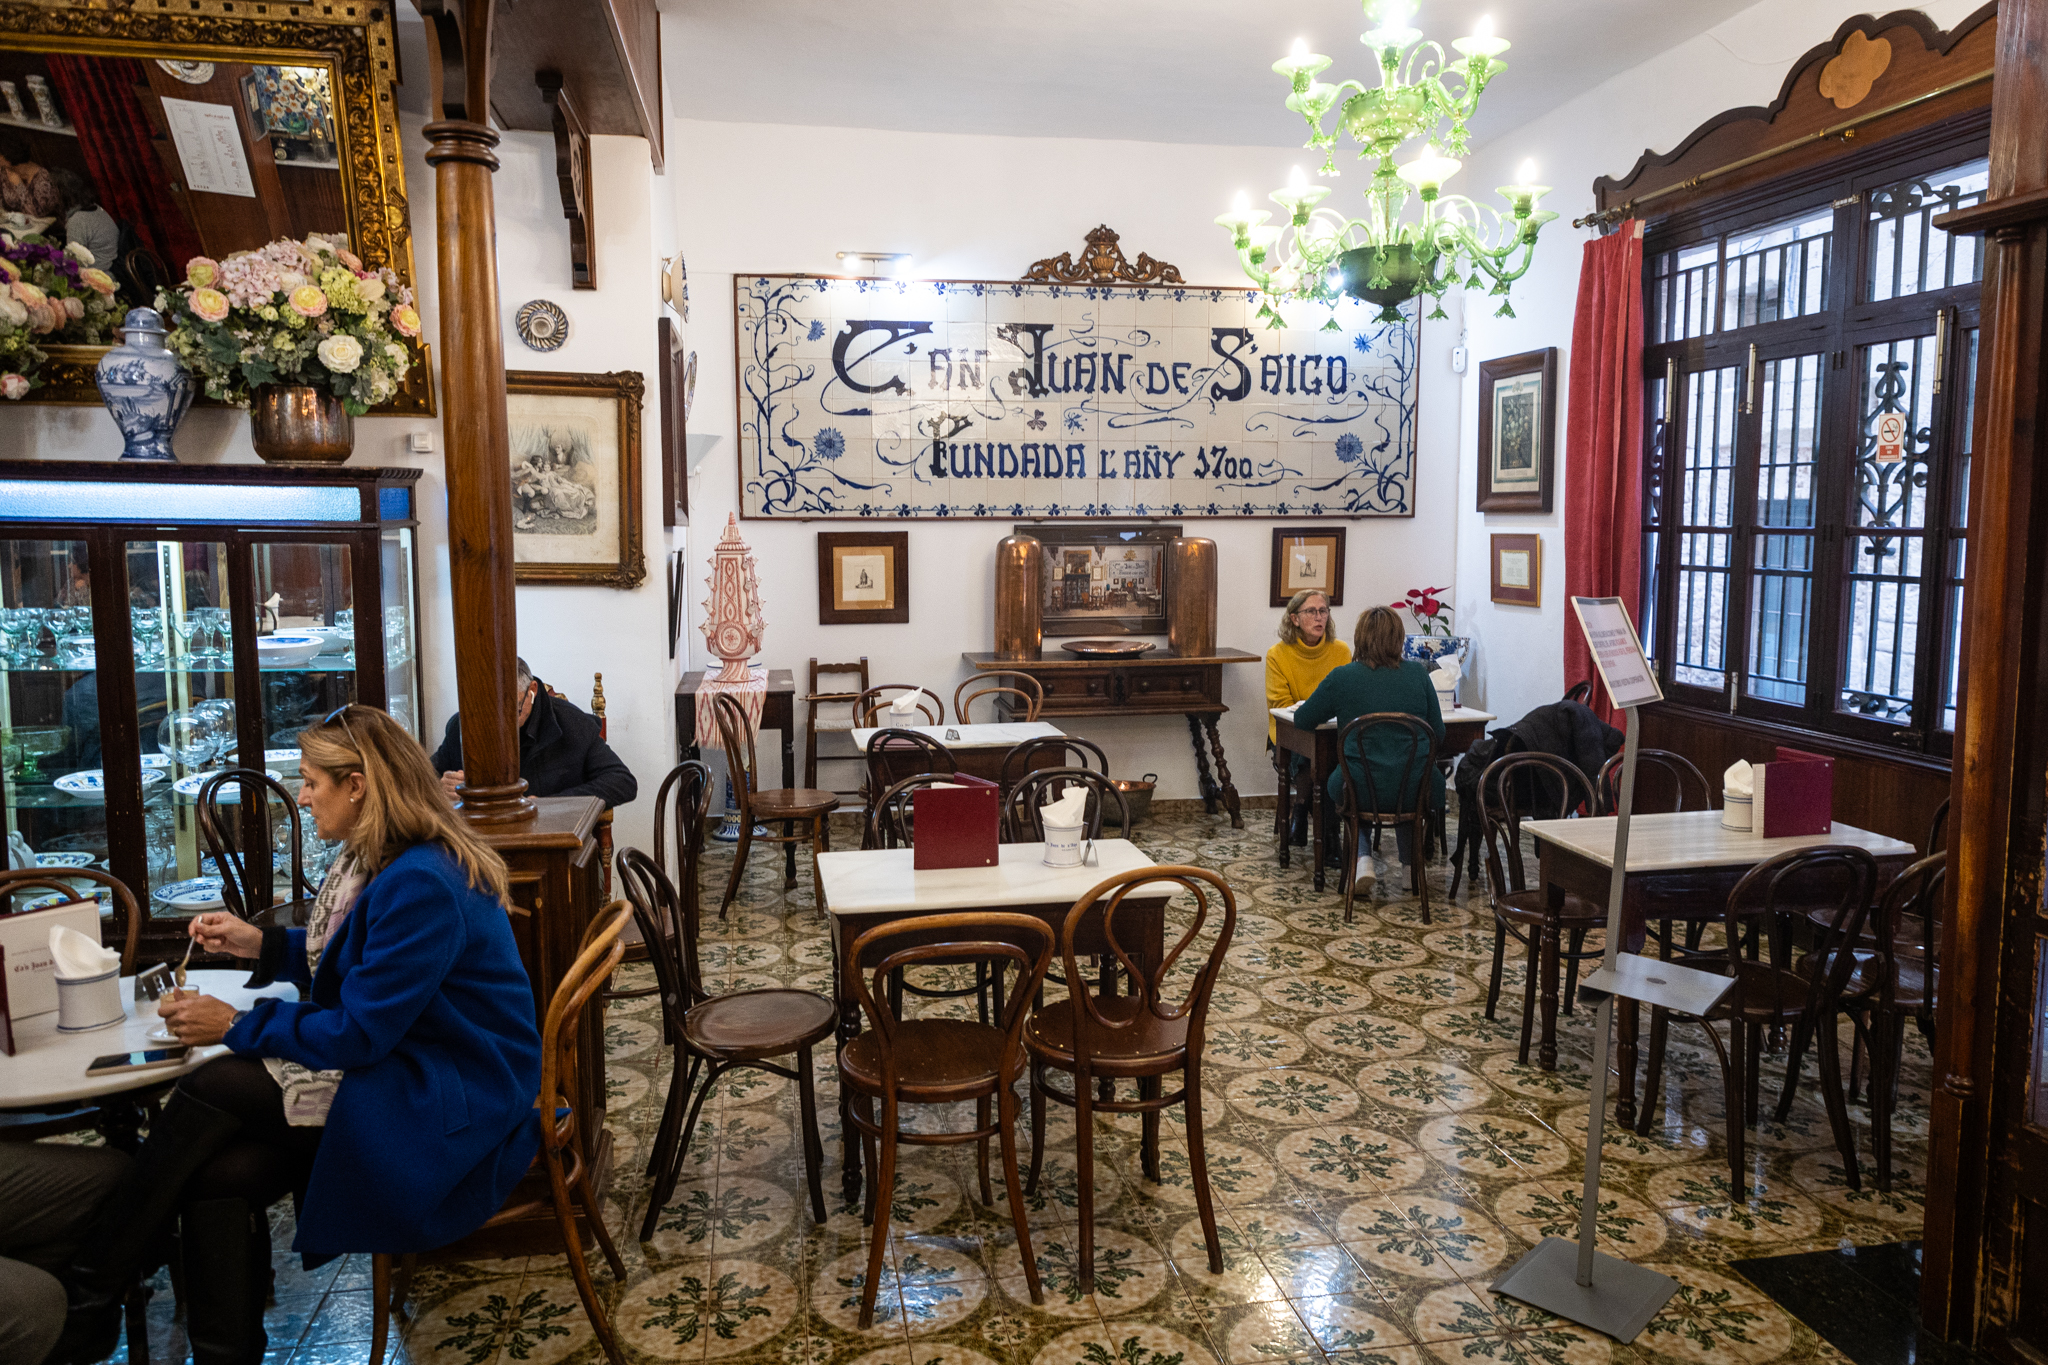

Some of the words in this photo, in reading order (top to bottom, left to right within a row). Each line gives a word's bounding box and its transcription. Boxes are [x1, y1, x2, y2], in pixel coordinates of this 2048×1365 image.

[996, 323, 1134, 398] JUAN
[1145, 362, 1192, 396] DE
[926, 410, 1087, 479] FUNDADA
